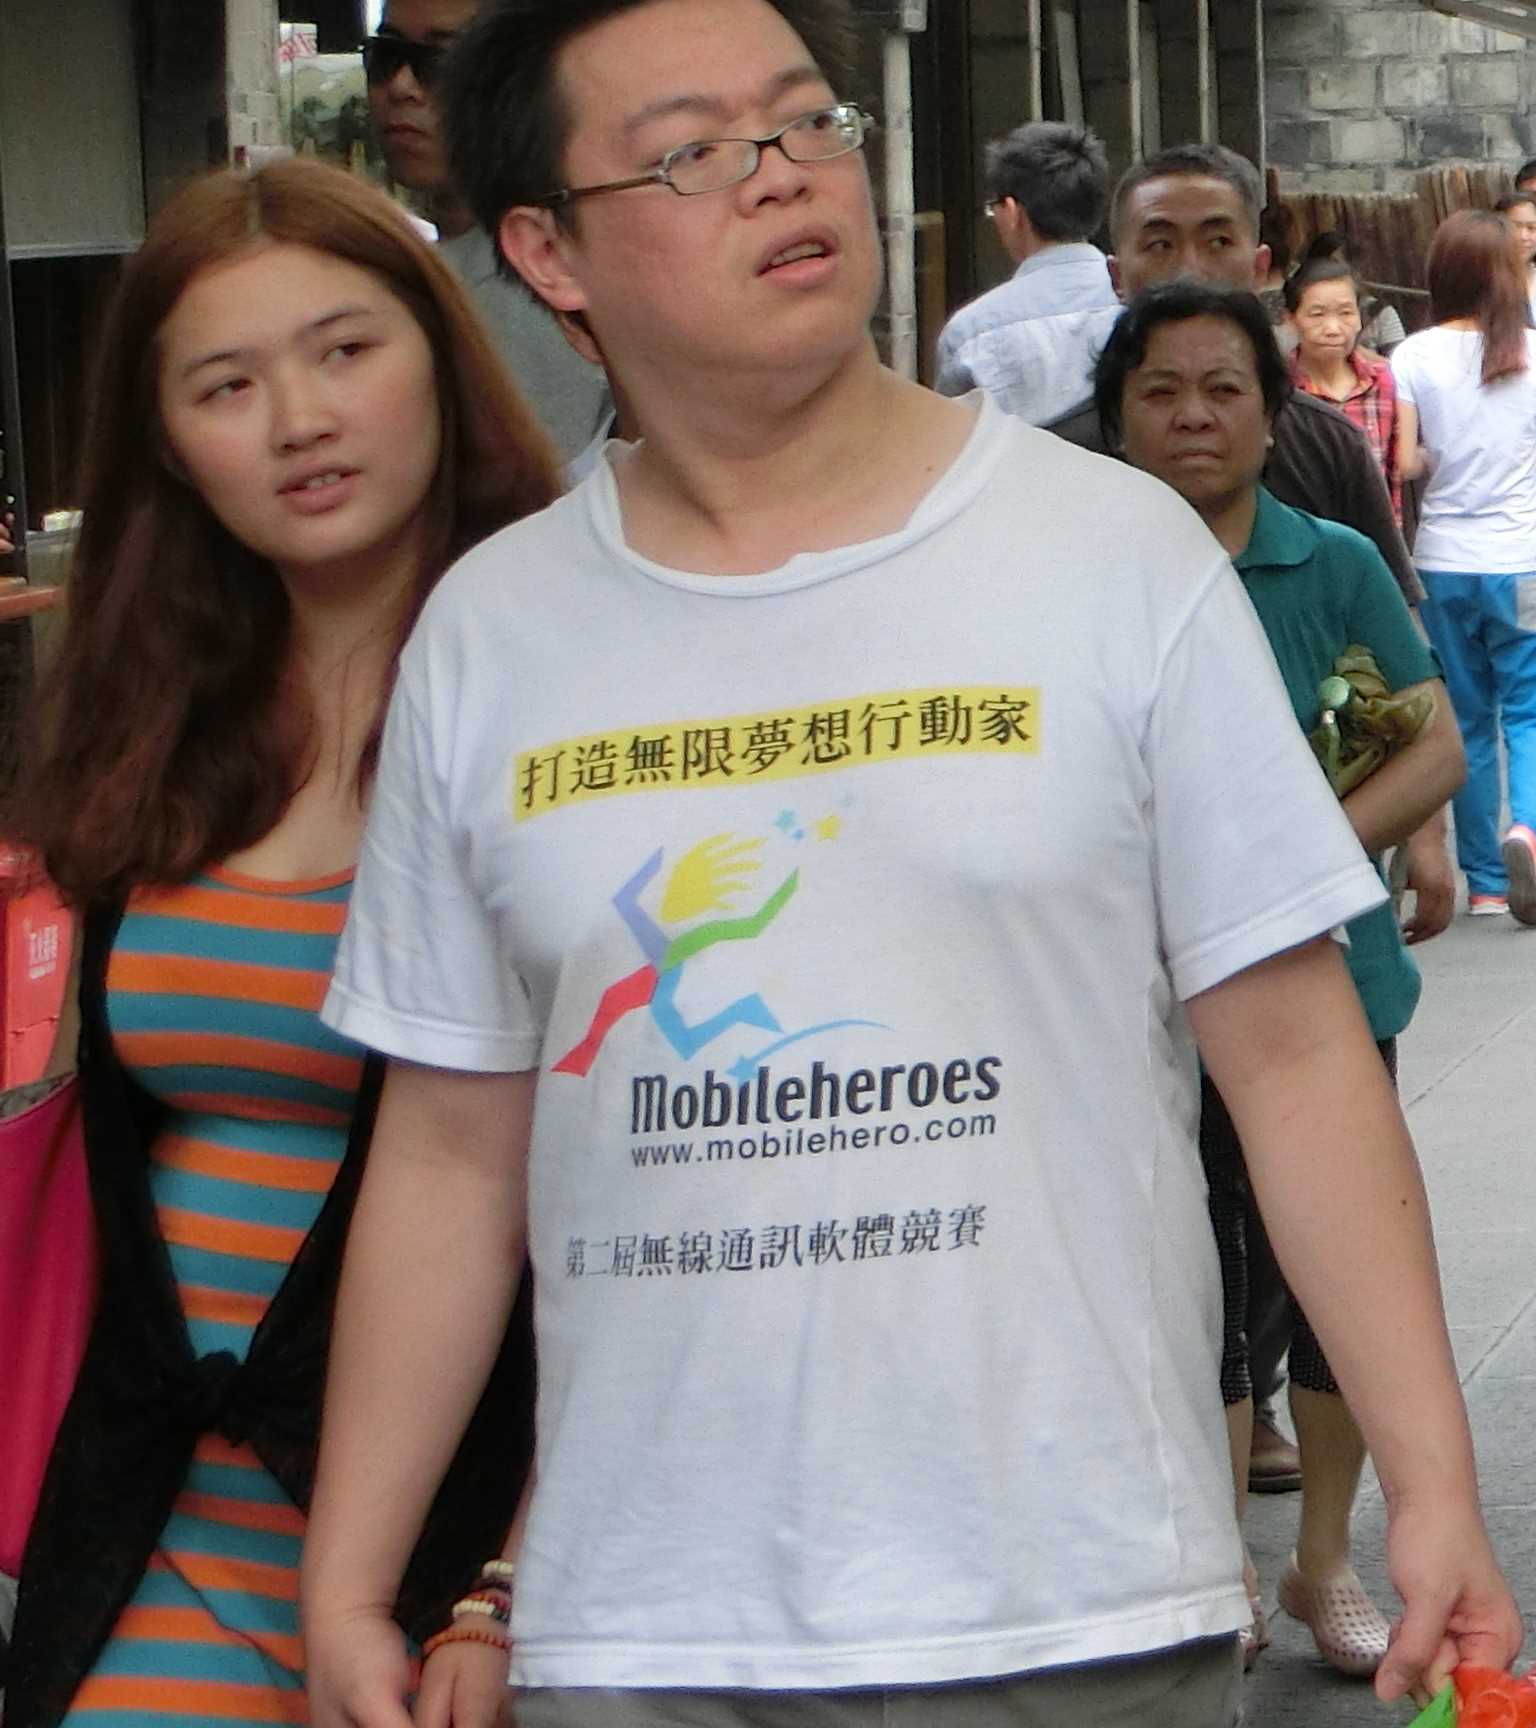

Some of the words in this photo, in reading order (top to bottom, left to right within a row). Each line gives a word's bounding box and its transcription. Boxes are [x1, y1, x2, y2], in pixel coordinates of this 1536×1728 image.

[519, 693, 1034, 810] 打造無限夢想行動家
[630, 1112, 997, 1168] www.mobilehero.com
